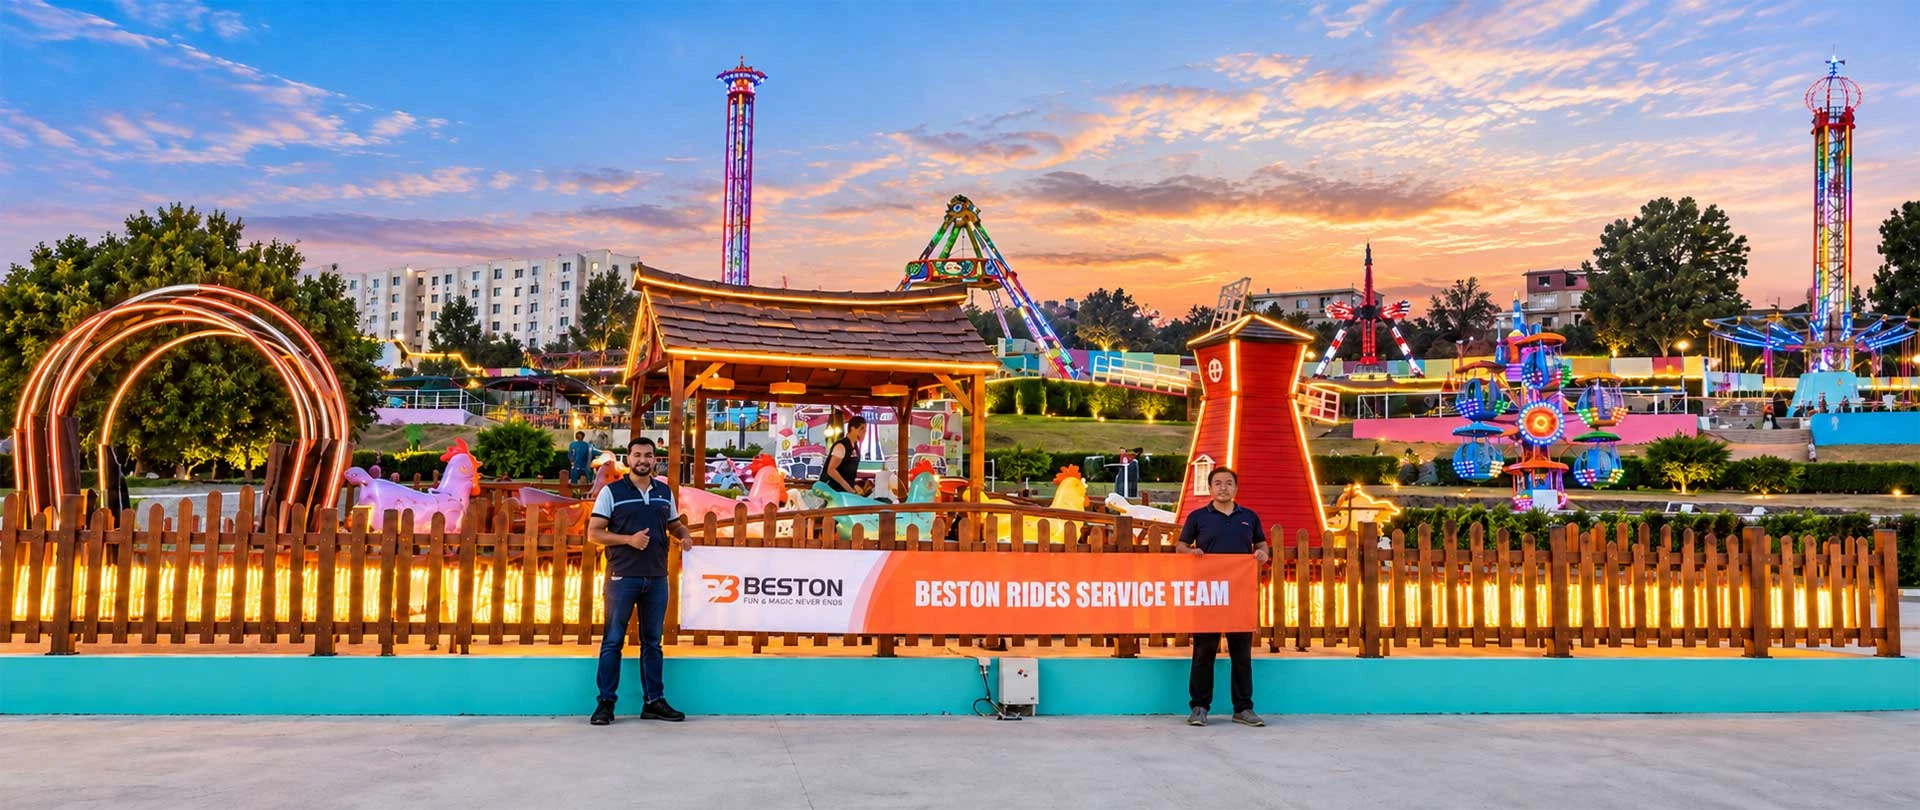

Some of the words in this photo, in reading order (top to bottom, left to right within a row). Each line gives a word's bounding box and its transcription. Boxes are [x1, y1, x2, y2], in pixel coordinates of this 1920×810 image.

[744, 577, 843, 596] BESTON
[915, 580, 1000, 607] BESTON
[1007, 581, 1071, 607] RIDES
[1076, 581, 1166, 607] SERVICE
[1171, 580, 1229, 607] TEAM
[743, 597, 759, 605] FUN
